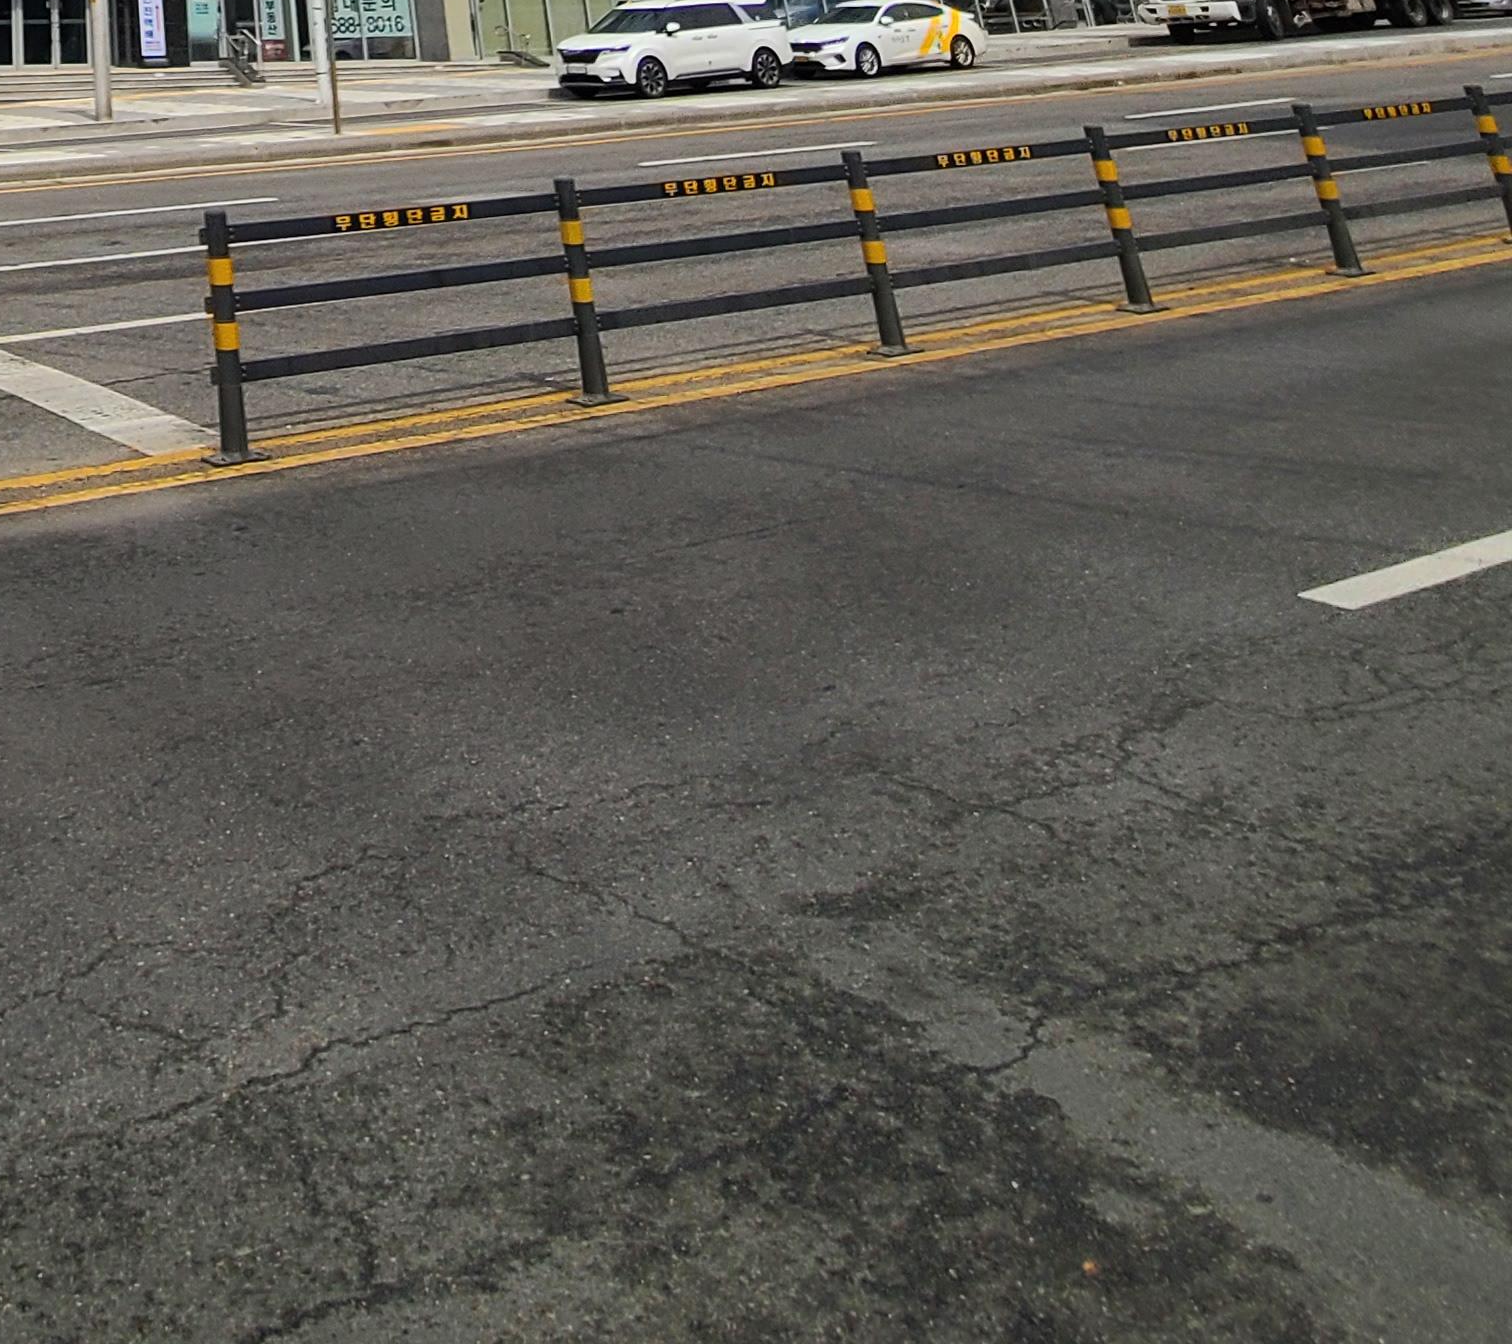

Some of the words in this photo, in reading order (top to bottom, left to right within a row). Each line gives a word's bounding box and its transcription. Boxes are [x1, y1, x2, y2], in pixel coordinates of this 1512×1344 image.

[1168, 122, 1249, 142] 무단횡단금지
[937, 145, 1032, 169] 무단횡단금지
[663, 172, 776, 196] 무단횡단금지
[334, 203, 470, 231] 무단횡단금지
